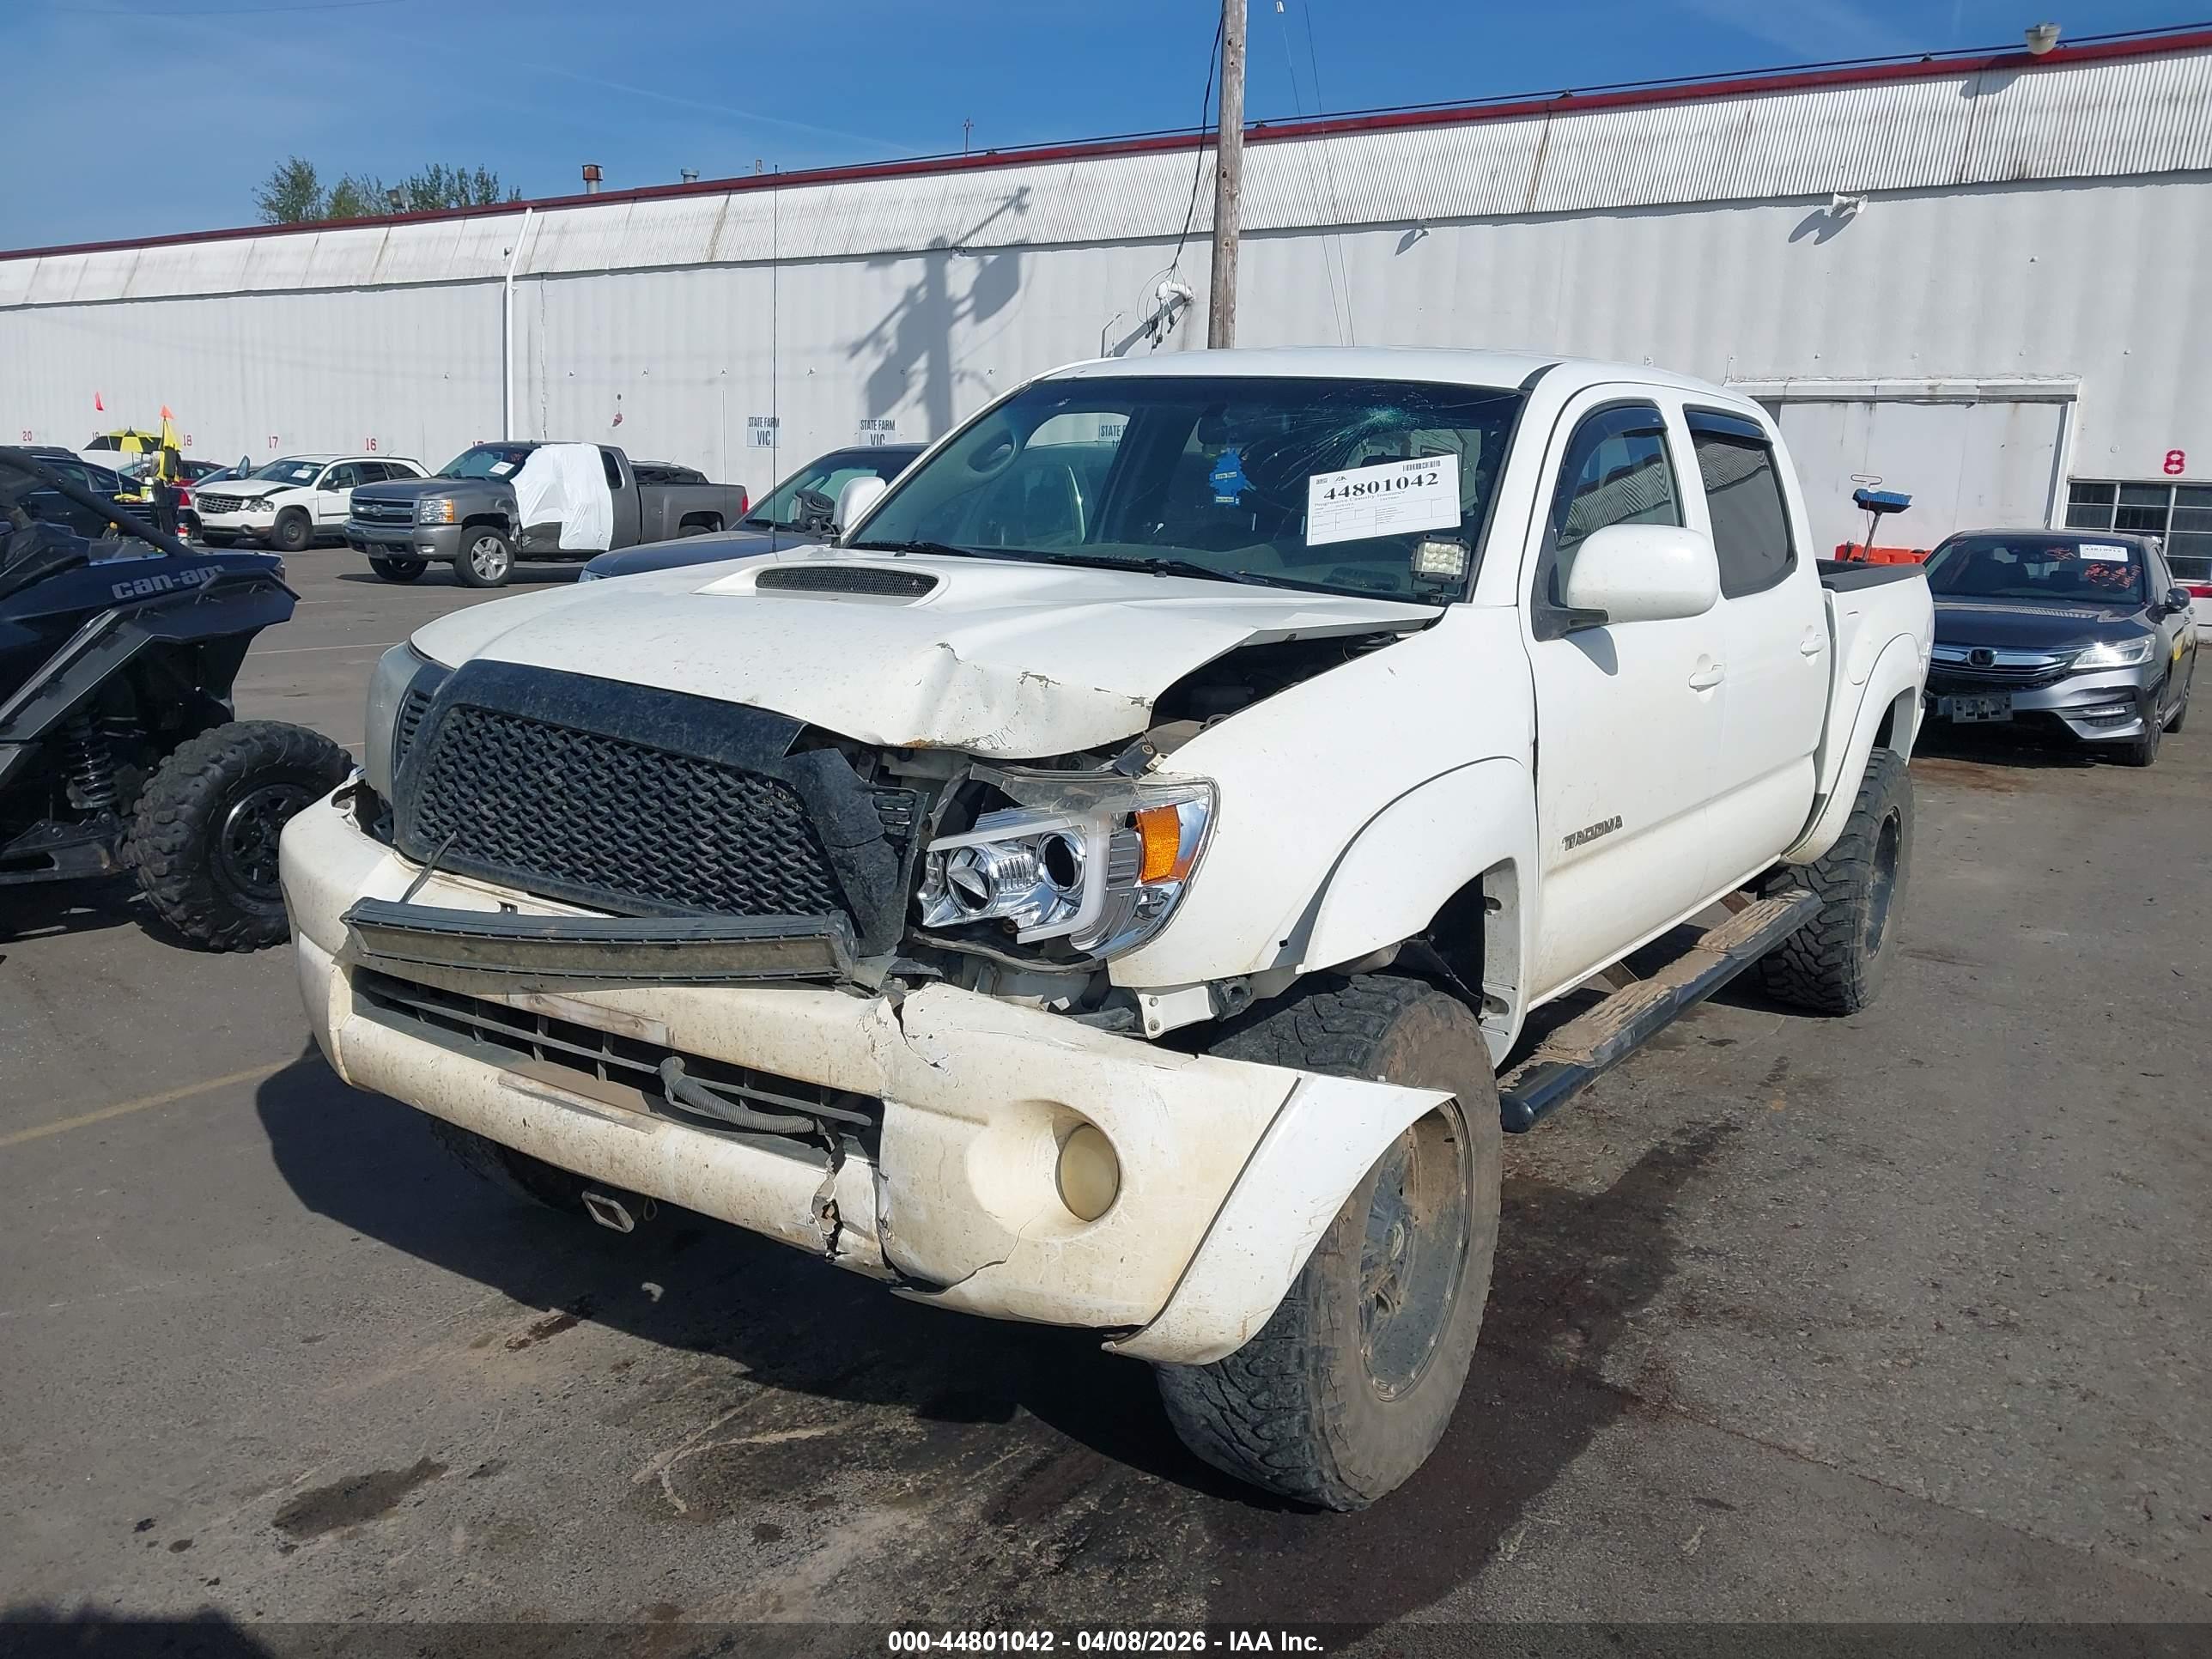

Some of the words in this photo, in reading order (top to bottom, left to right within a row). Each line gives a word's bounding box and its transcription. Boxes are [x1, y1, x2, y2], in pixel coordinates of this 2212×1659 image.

[748, 416, 763, 428] STATE
[764, 417, 780, 428] FARM
[860, 420, 878, 430] STATE
[878, 419, 896, 431] FARM
[22, 431, 33, 441] 20
[757, 429, 771, 446] VIC
[1101, 425, 1121, 436] STATE
[183, 434, 192, 447] 18
[268, 435, 278, 449] 17
[365, 437, 377, 451] 16
[870, 433, 885, 447] VIC
[2163, 449, 2186, 476] 8
[1323, 472, 1438, 500] 44801042
[111, 564, 226, 600] can-am
[1562, 815, 1624, 852] TACOMA
